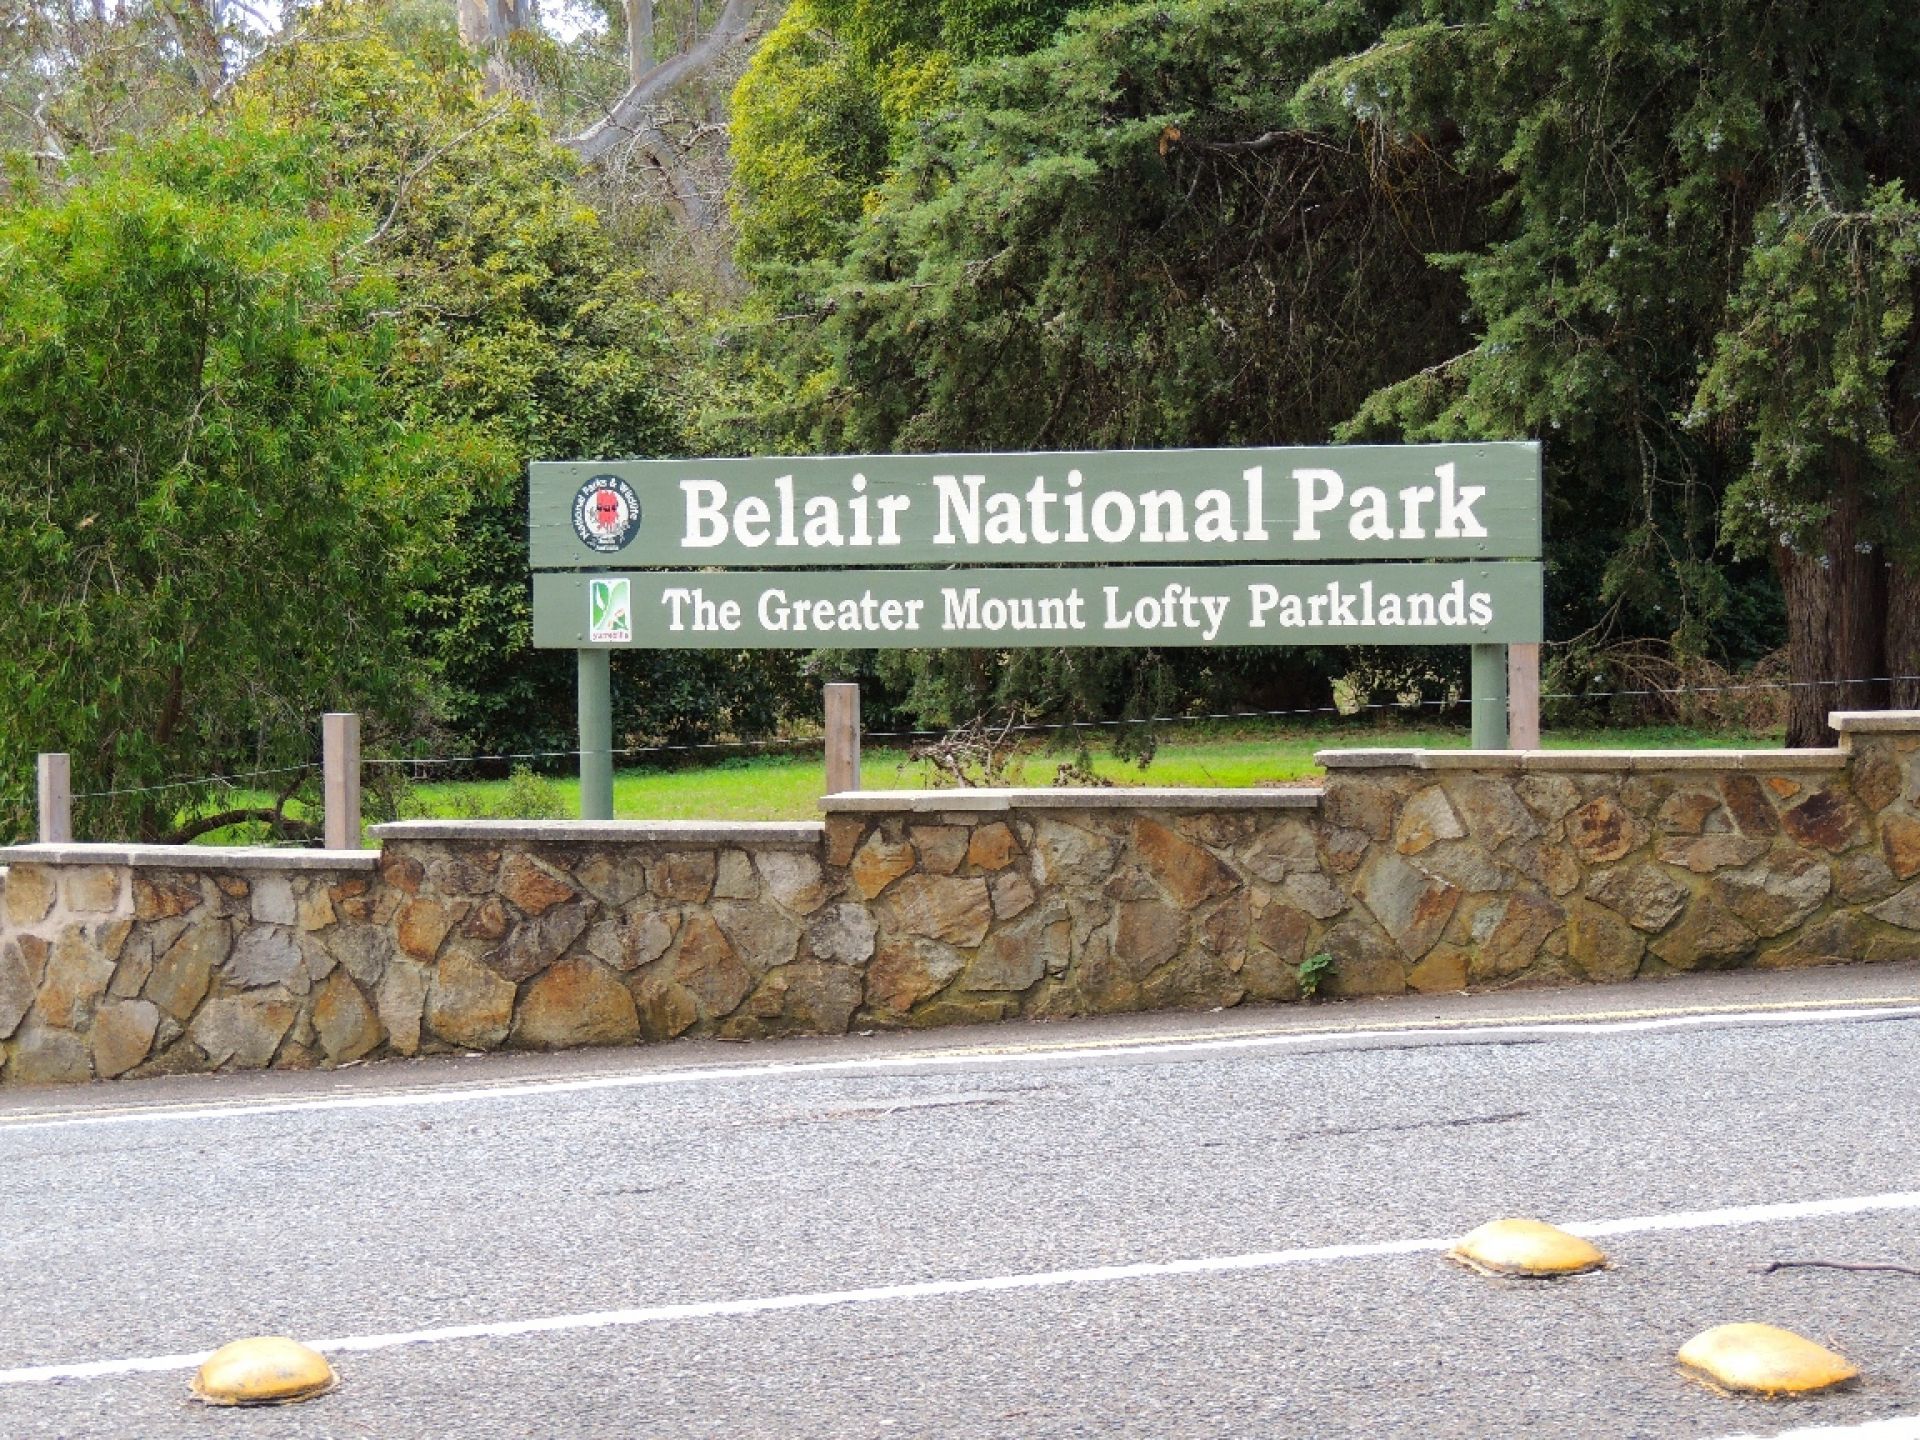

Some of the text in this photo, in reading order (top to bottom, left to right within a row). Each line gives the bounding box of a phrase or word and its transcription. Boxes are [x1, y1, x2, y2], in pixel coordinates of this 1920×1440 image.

[678, 461, 1490, 550] Belair National Park
[660, 577, 1494, 641] The Greater Mount Lofty Parklands
